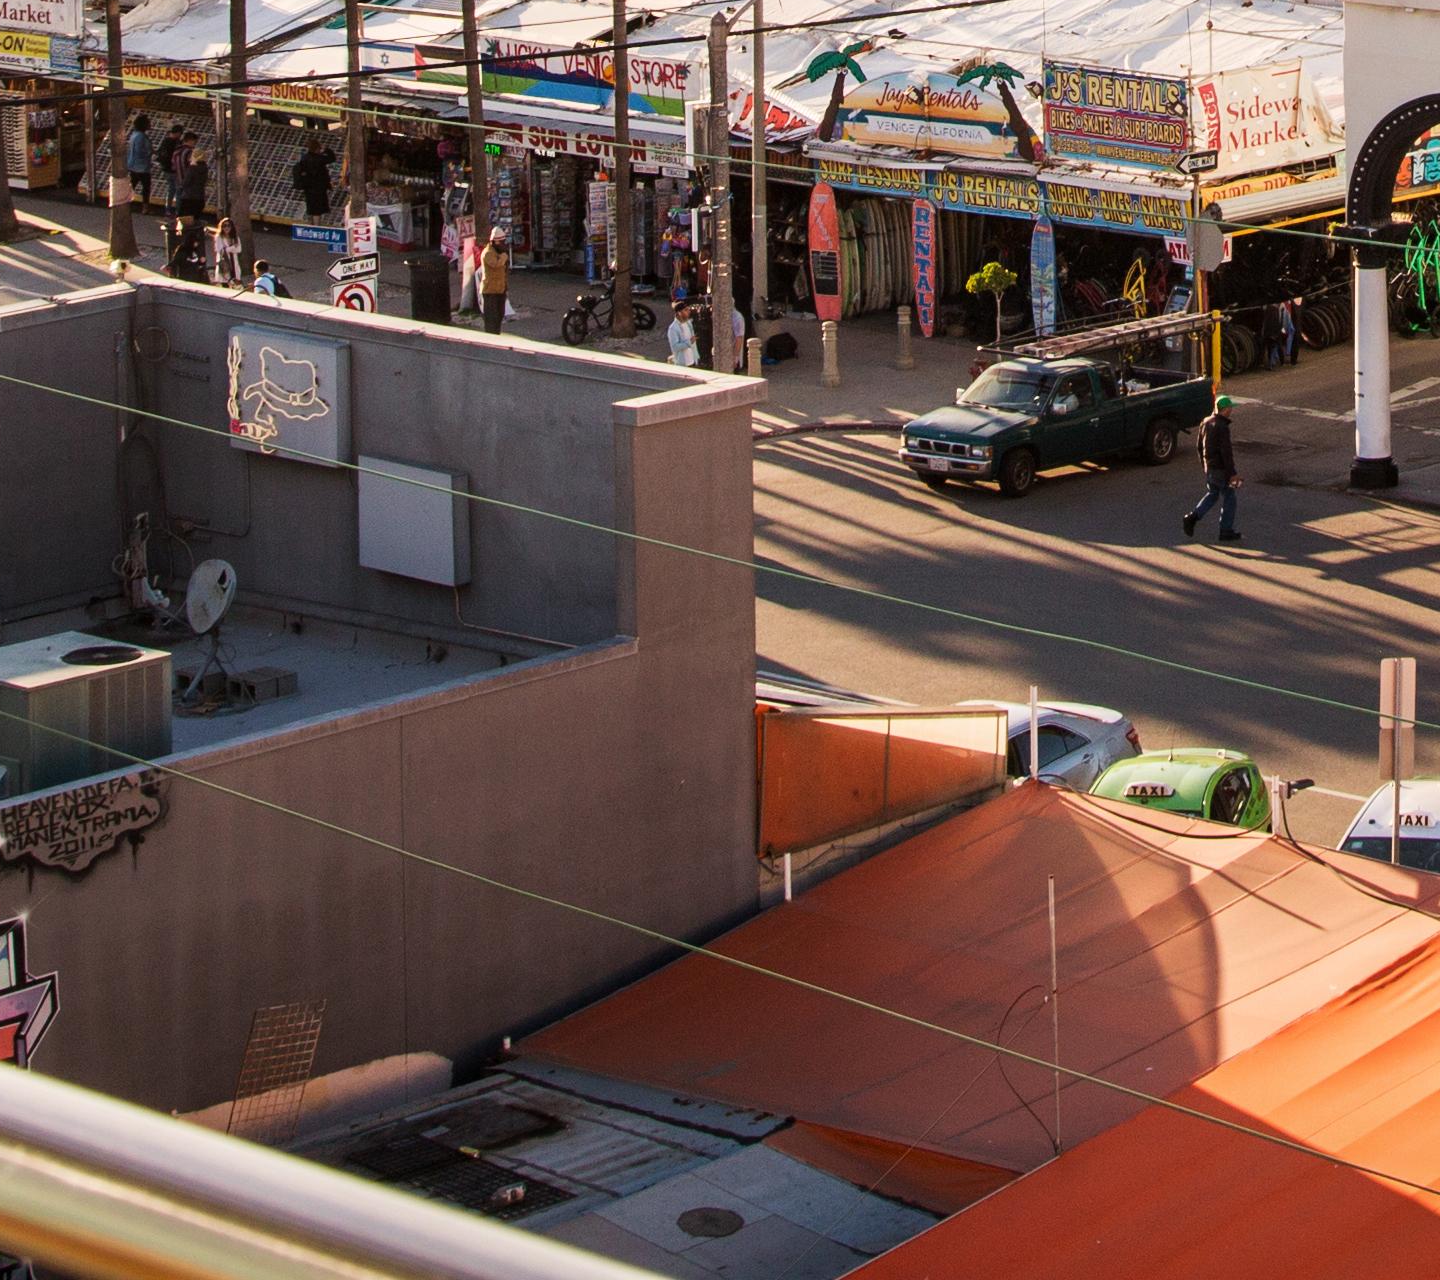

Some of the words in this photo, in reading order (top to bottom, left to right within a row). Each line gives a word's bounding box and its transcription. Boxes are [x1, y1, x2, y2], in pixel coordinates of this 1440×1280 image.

[123, 59, 206, 85] SUNGLASSES
[497, 42, 551, 73] LUCKY
[562, 54, 614, 82] VENIC
[631, 58, 687, 92] STORE
[1050, 70, 1082, 104] J'S
[1086, 74, 1181, 116] RENTALS
[1050, 107, 1076, 131] BIKES
[1082, 111, 1114, 136] SKATES
[1116, 116, 1123, 138] &
[1124, 118, 1146, 140] SURF
[1147, 121, 1183, 145] BOARDS
[1201, 90, 1219, 147] ENICE
[1226, 95, 1303, 126] Sidewa
[484, 143, 501, 155] ATM
[528, 125, 568, 153] SUN
[1227, 120, 1308, 154] Marke
[819, 158, 853, 182] SURF
[859, 163, 921, 191] LESSONS
[1187, 159, 1202, 168] ONE
[1201, 154, 1216, 165] WAY
[935, 171, 960, 204] J'S
[963, 175, 1041, 213] RENTALS
[1046, 182, 1095, 221] SURFING
[1099, 188, 1135, 226] BIKES
[1140, 193, 1185, 232] SKATES
[296, 228, 330, 240] Windward
[342, 262, 356, 274] ONE
[359, 259, 375, 272] WAY
[913, 206, 934, 325] RENTALS
[1131, 785, 1165, 796] TAXI
[1399, 814, 1429, 826] TAXI
